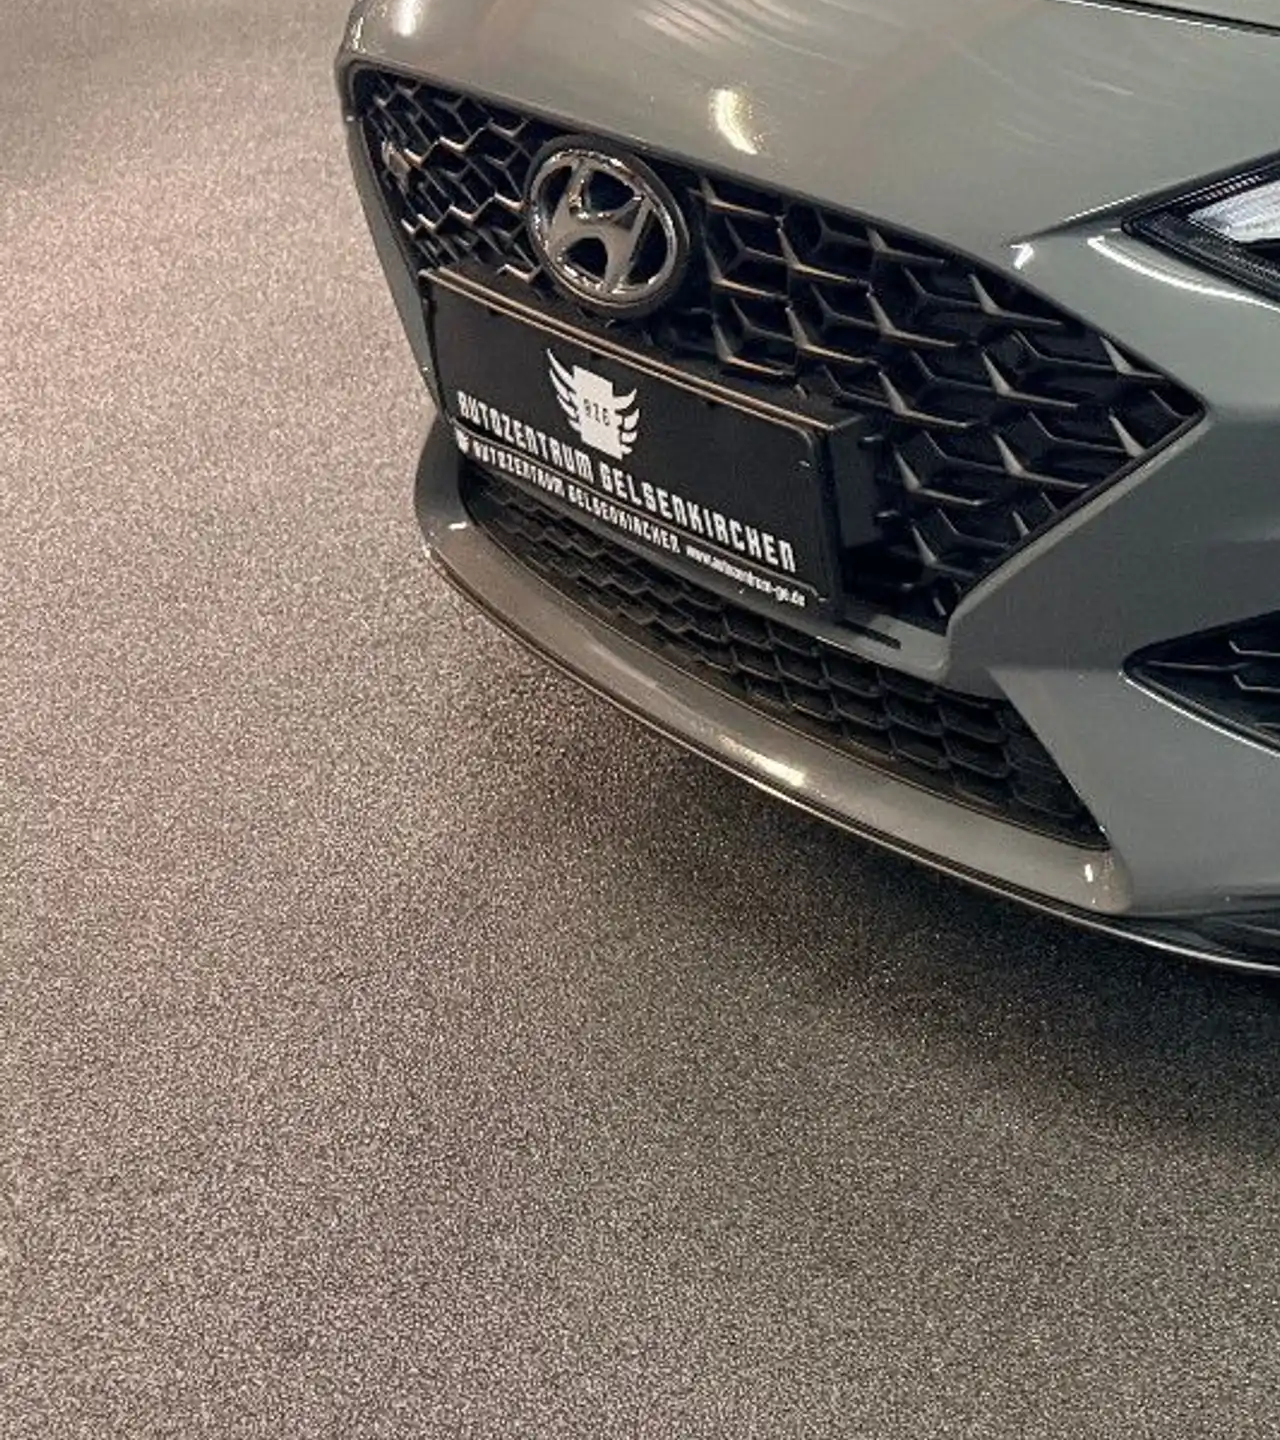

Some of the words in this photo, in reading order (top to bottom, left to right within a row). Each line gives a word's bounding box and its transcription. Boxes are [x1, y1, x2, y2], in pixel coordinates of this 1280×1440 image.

[456, 390, 595, 485] AUTOZENTRUM
[599, 460, 796, 574] GELSENKIRCHEN
[472, 439, 565, 498] AUTOZENTRUM
[568, 484, 681, 555] GELSENKIRCHEN
